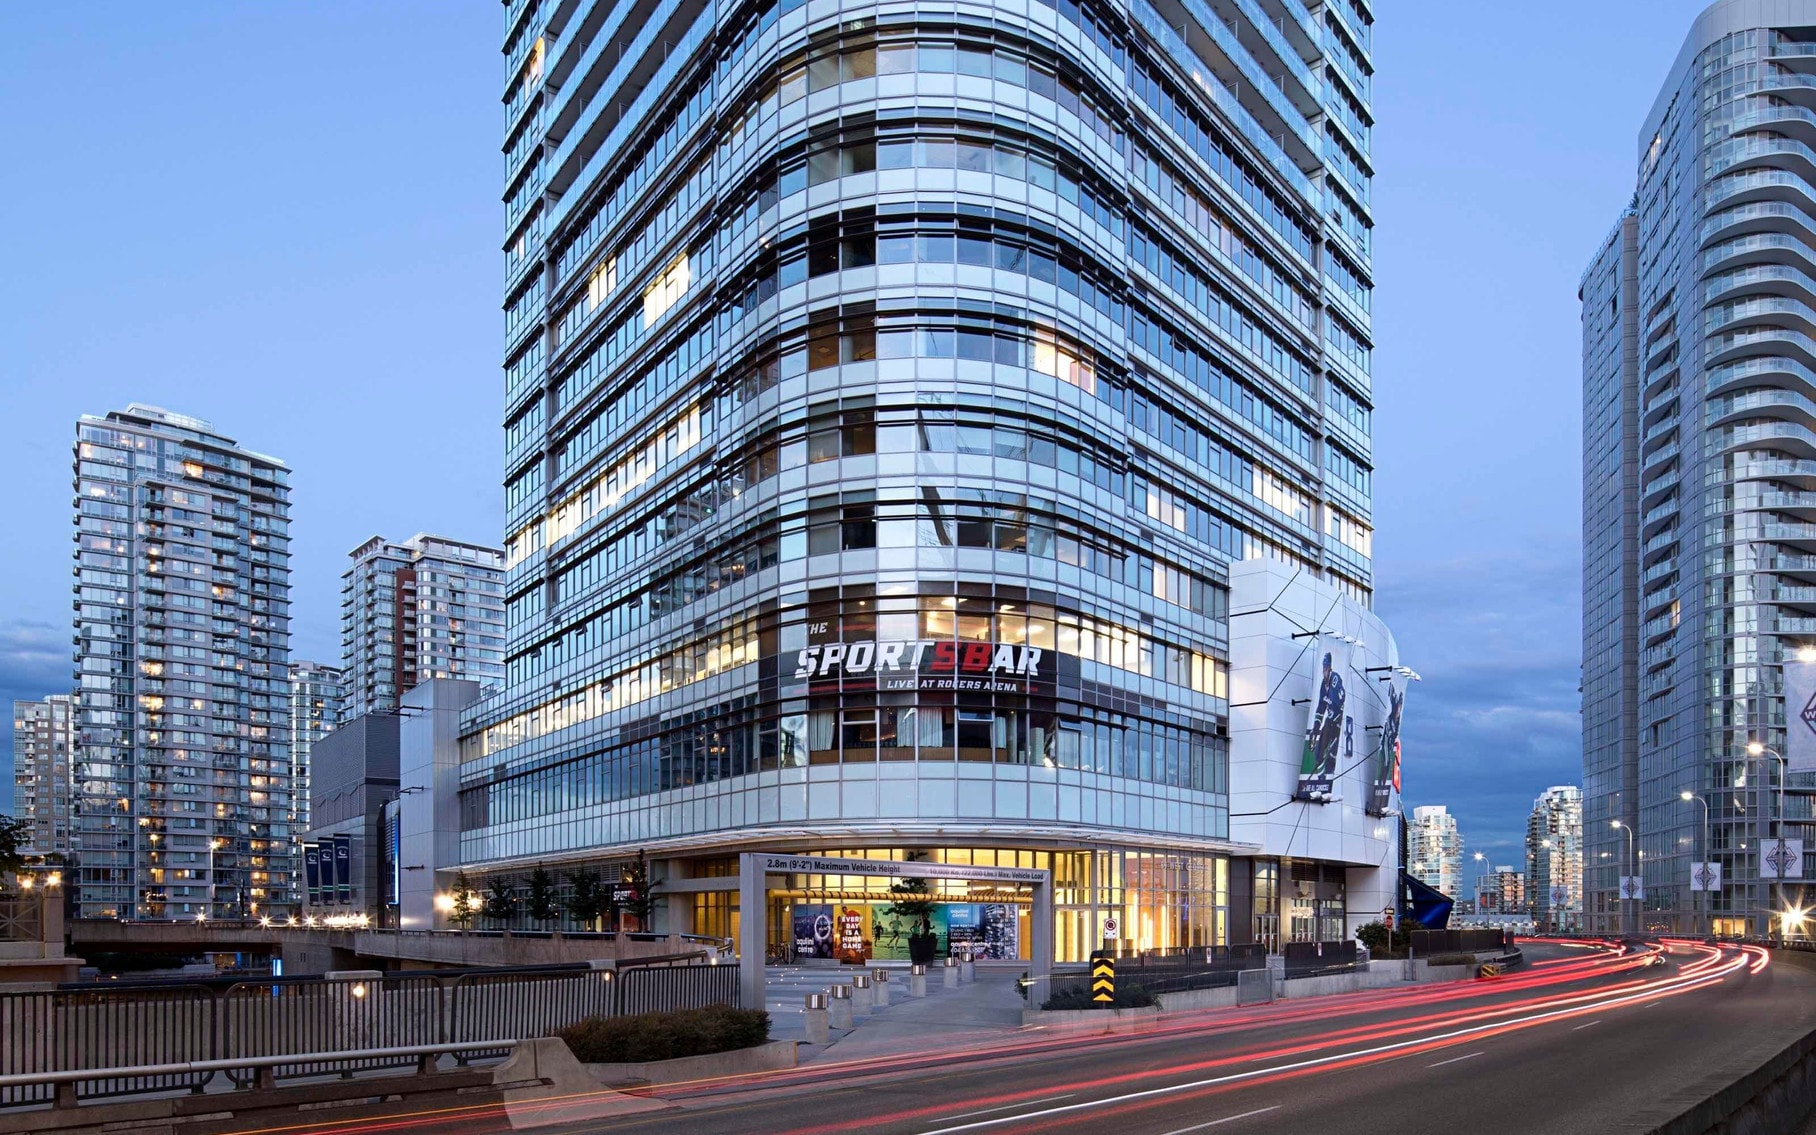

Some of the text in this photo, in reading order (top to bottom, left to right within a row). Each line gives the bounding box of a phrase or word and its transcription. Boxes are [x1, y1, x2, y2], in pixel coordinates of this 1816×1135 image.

[887, 680, 915, 689] LIVE
[920, 679, 935, 689] AT
[767, 859, 787, 868] 2.8m
[814, 861, 849, 871] Maximum
[851, 863, 877, 872] Vehicle
[879, 864, 901, 874] Height
[1012, 871, 1030, 879] Vehicle
